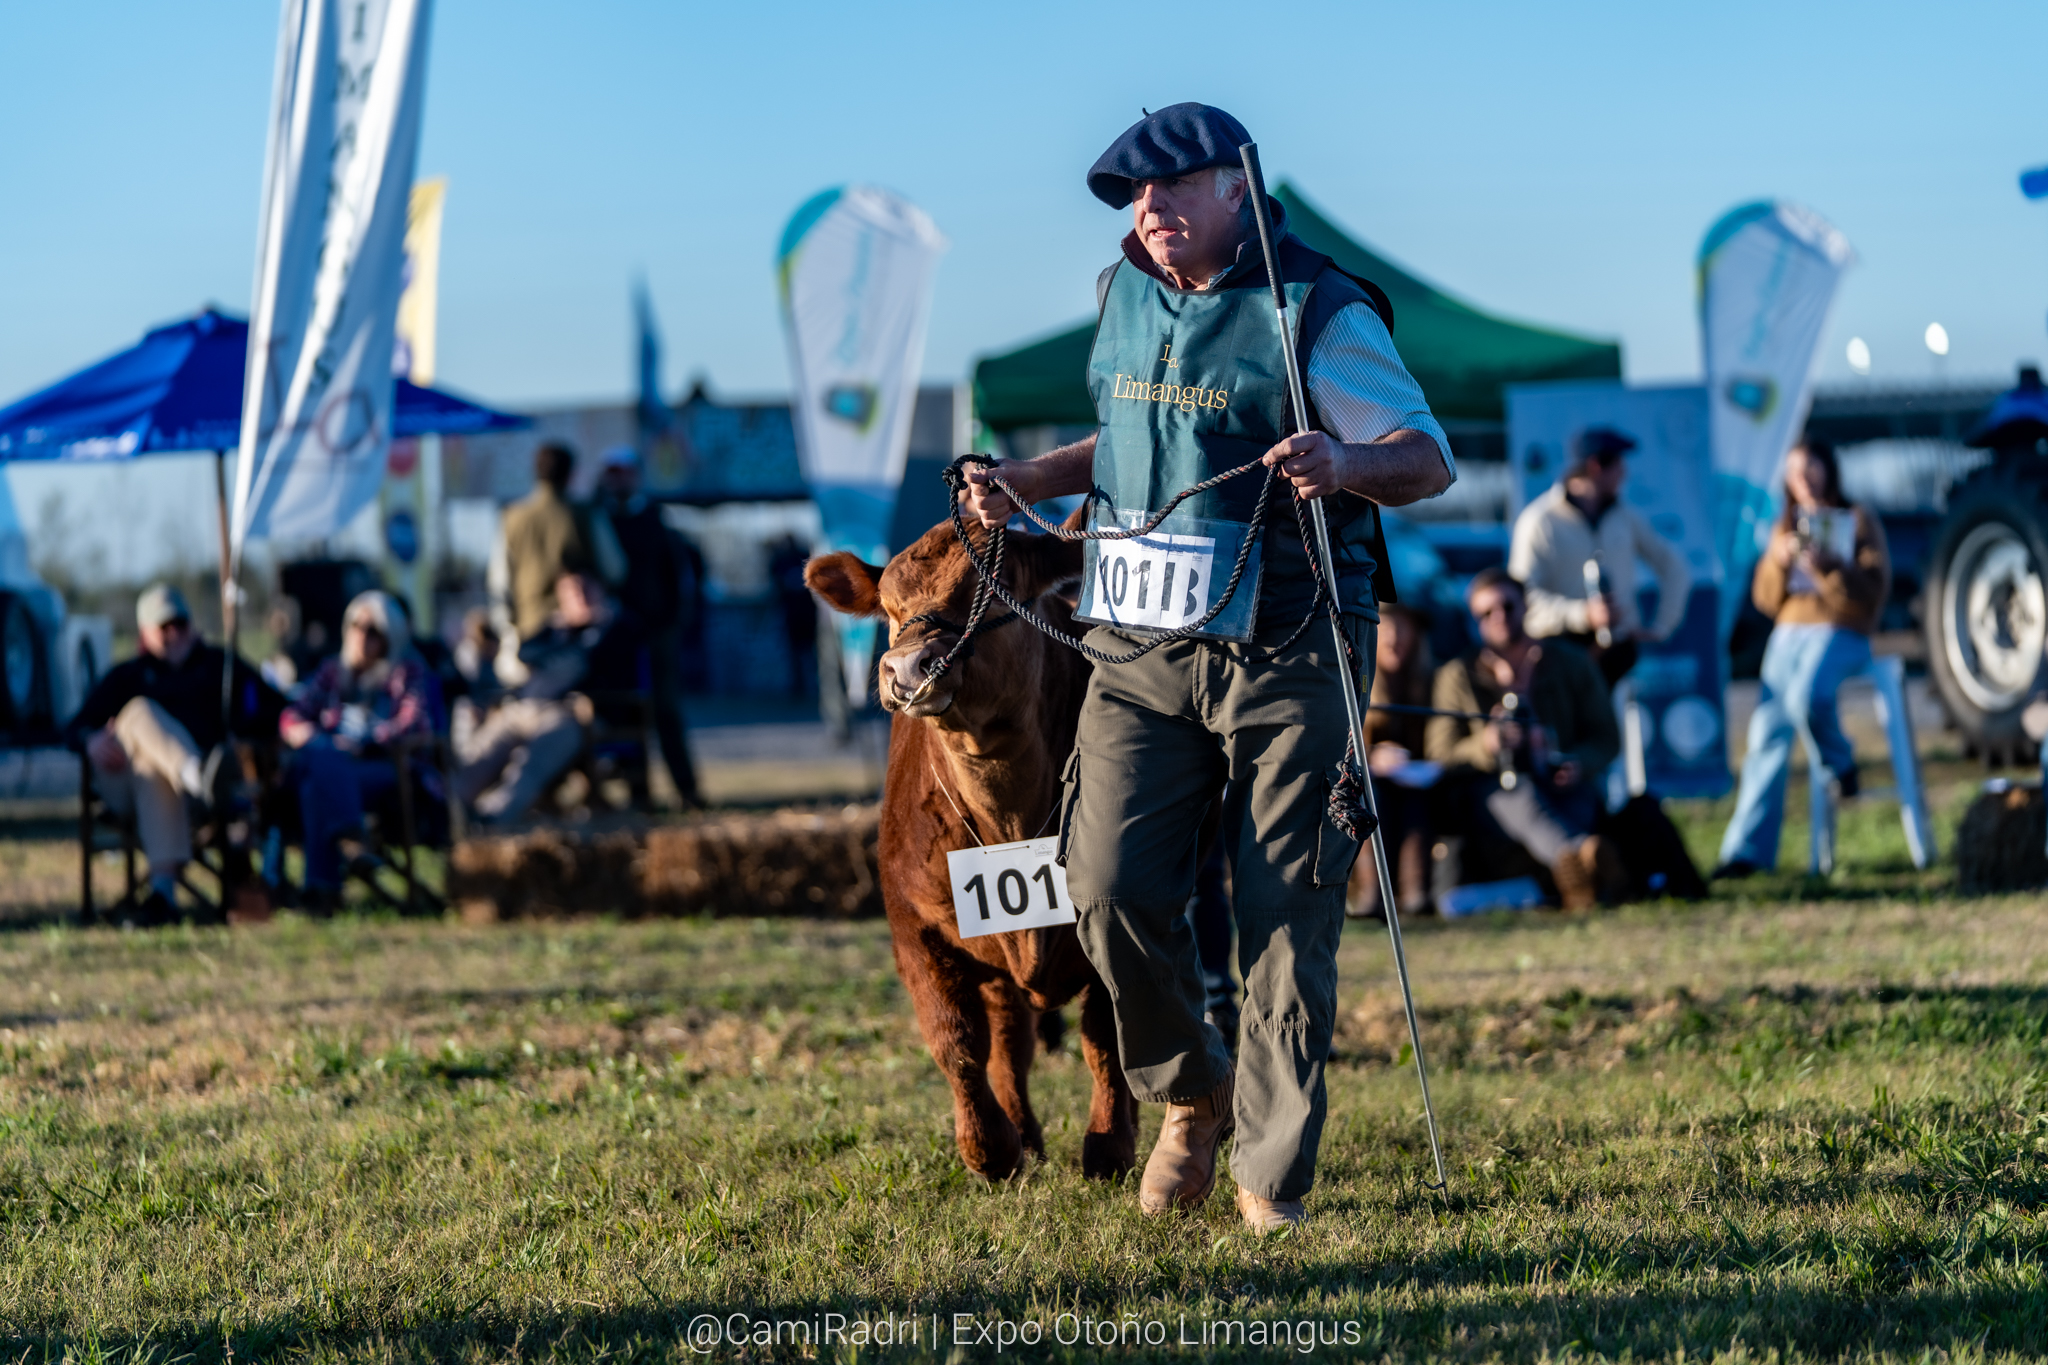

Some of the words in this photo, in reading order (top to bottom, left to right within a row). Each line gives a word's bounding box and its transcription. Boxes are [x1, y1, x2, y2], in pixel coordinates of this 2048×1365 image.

[1160, 344, 1179, 368] La
[1112, 373, 1228, 412] Limangus
[963, 863, 1058, 920] 101
